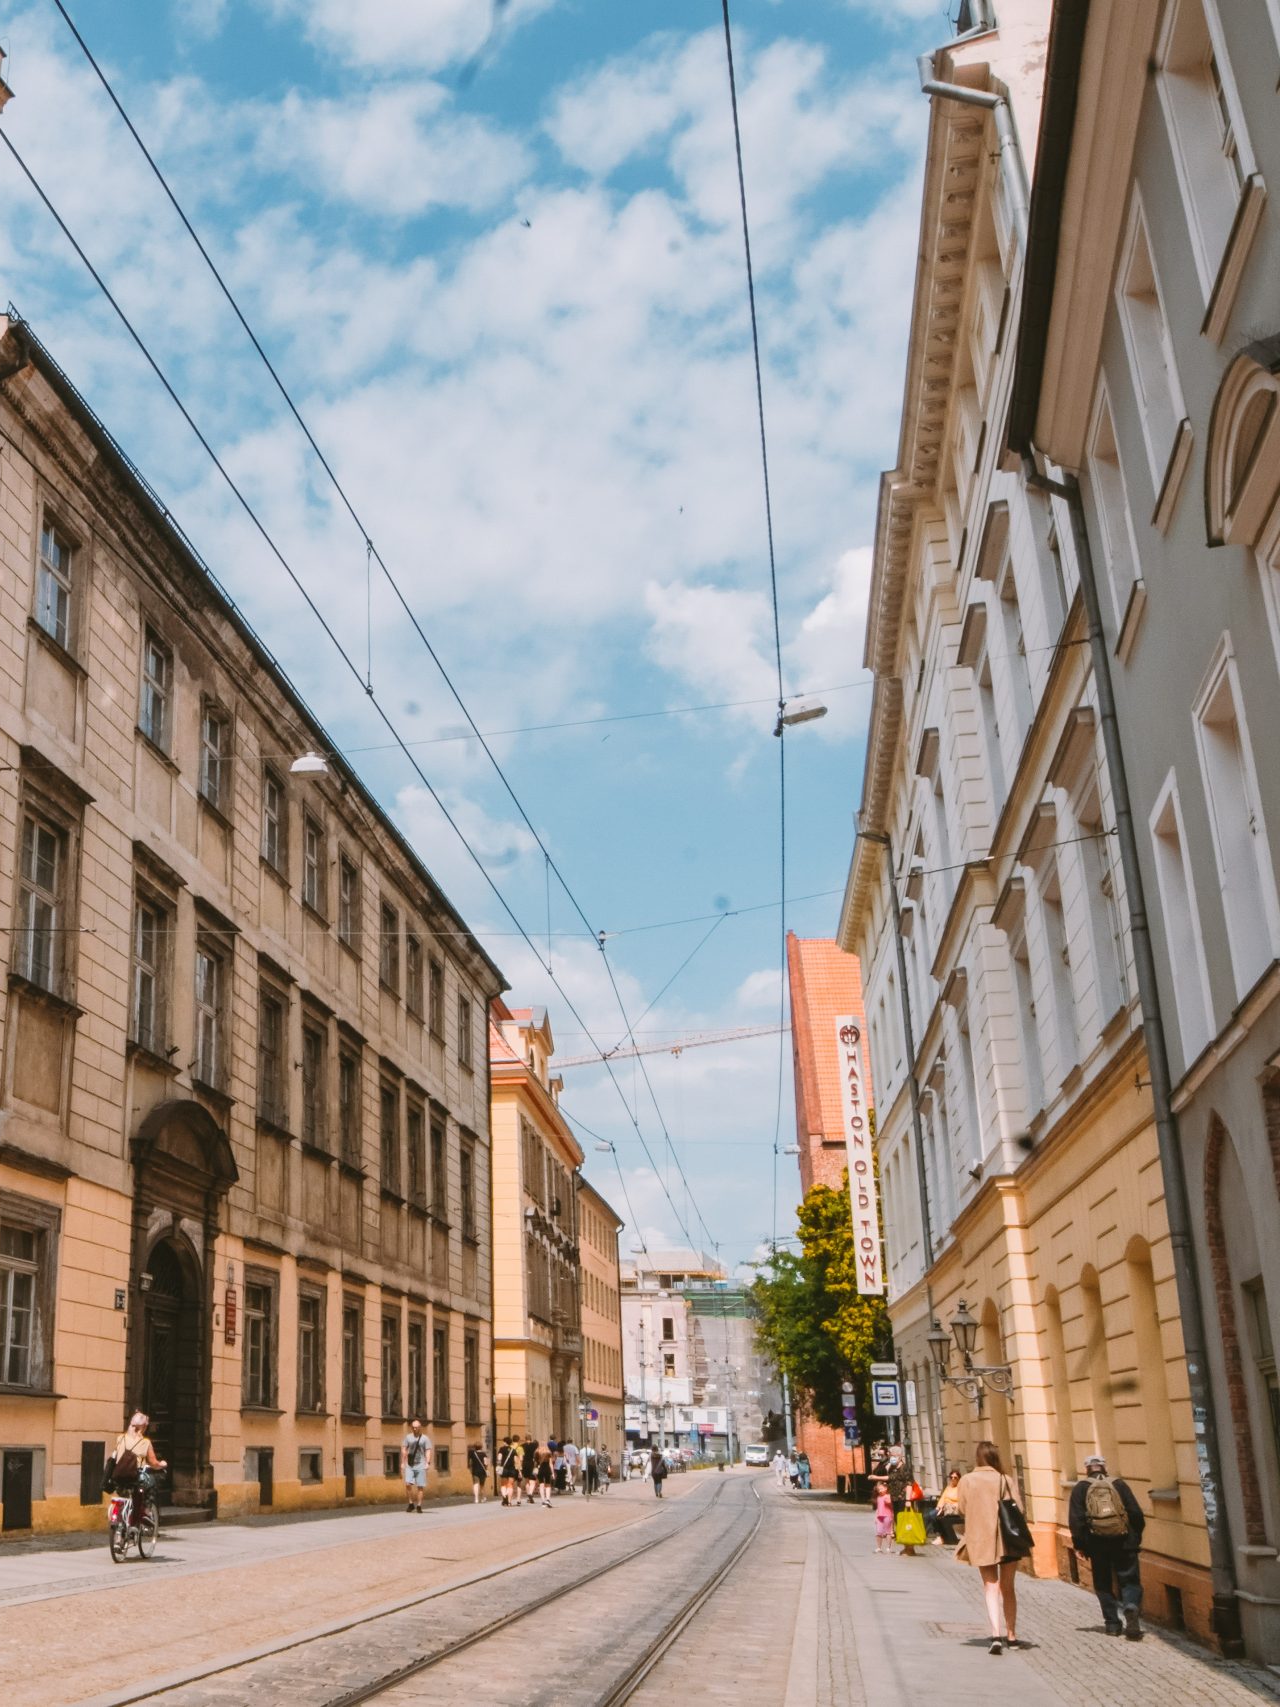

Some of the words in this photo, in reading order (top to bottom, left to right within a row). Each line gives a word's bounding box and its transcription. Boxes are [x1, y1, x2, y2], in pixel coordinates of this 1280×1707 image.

[846, 1050, 865, 1149] HASTON
[854, 1160, 869, 1210] OLD
[859, 1220, 877, 1288] TOWN
